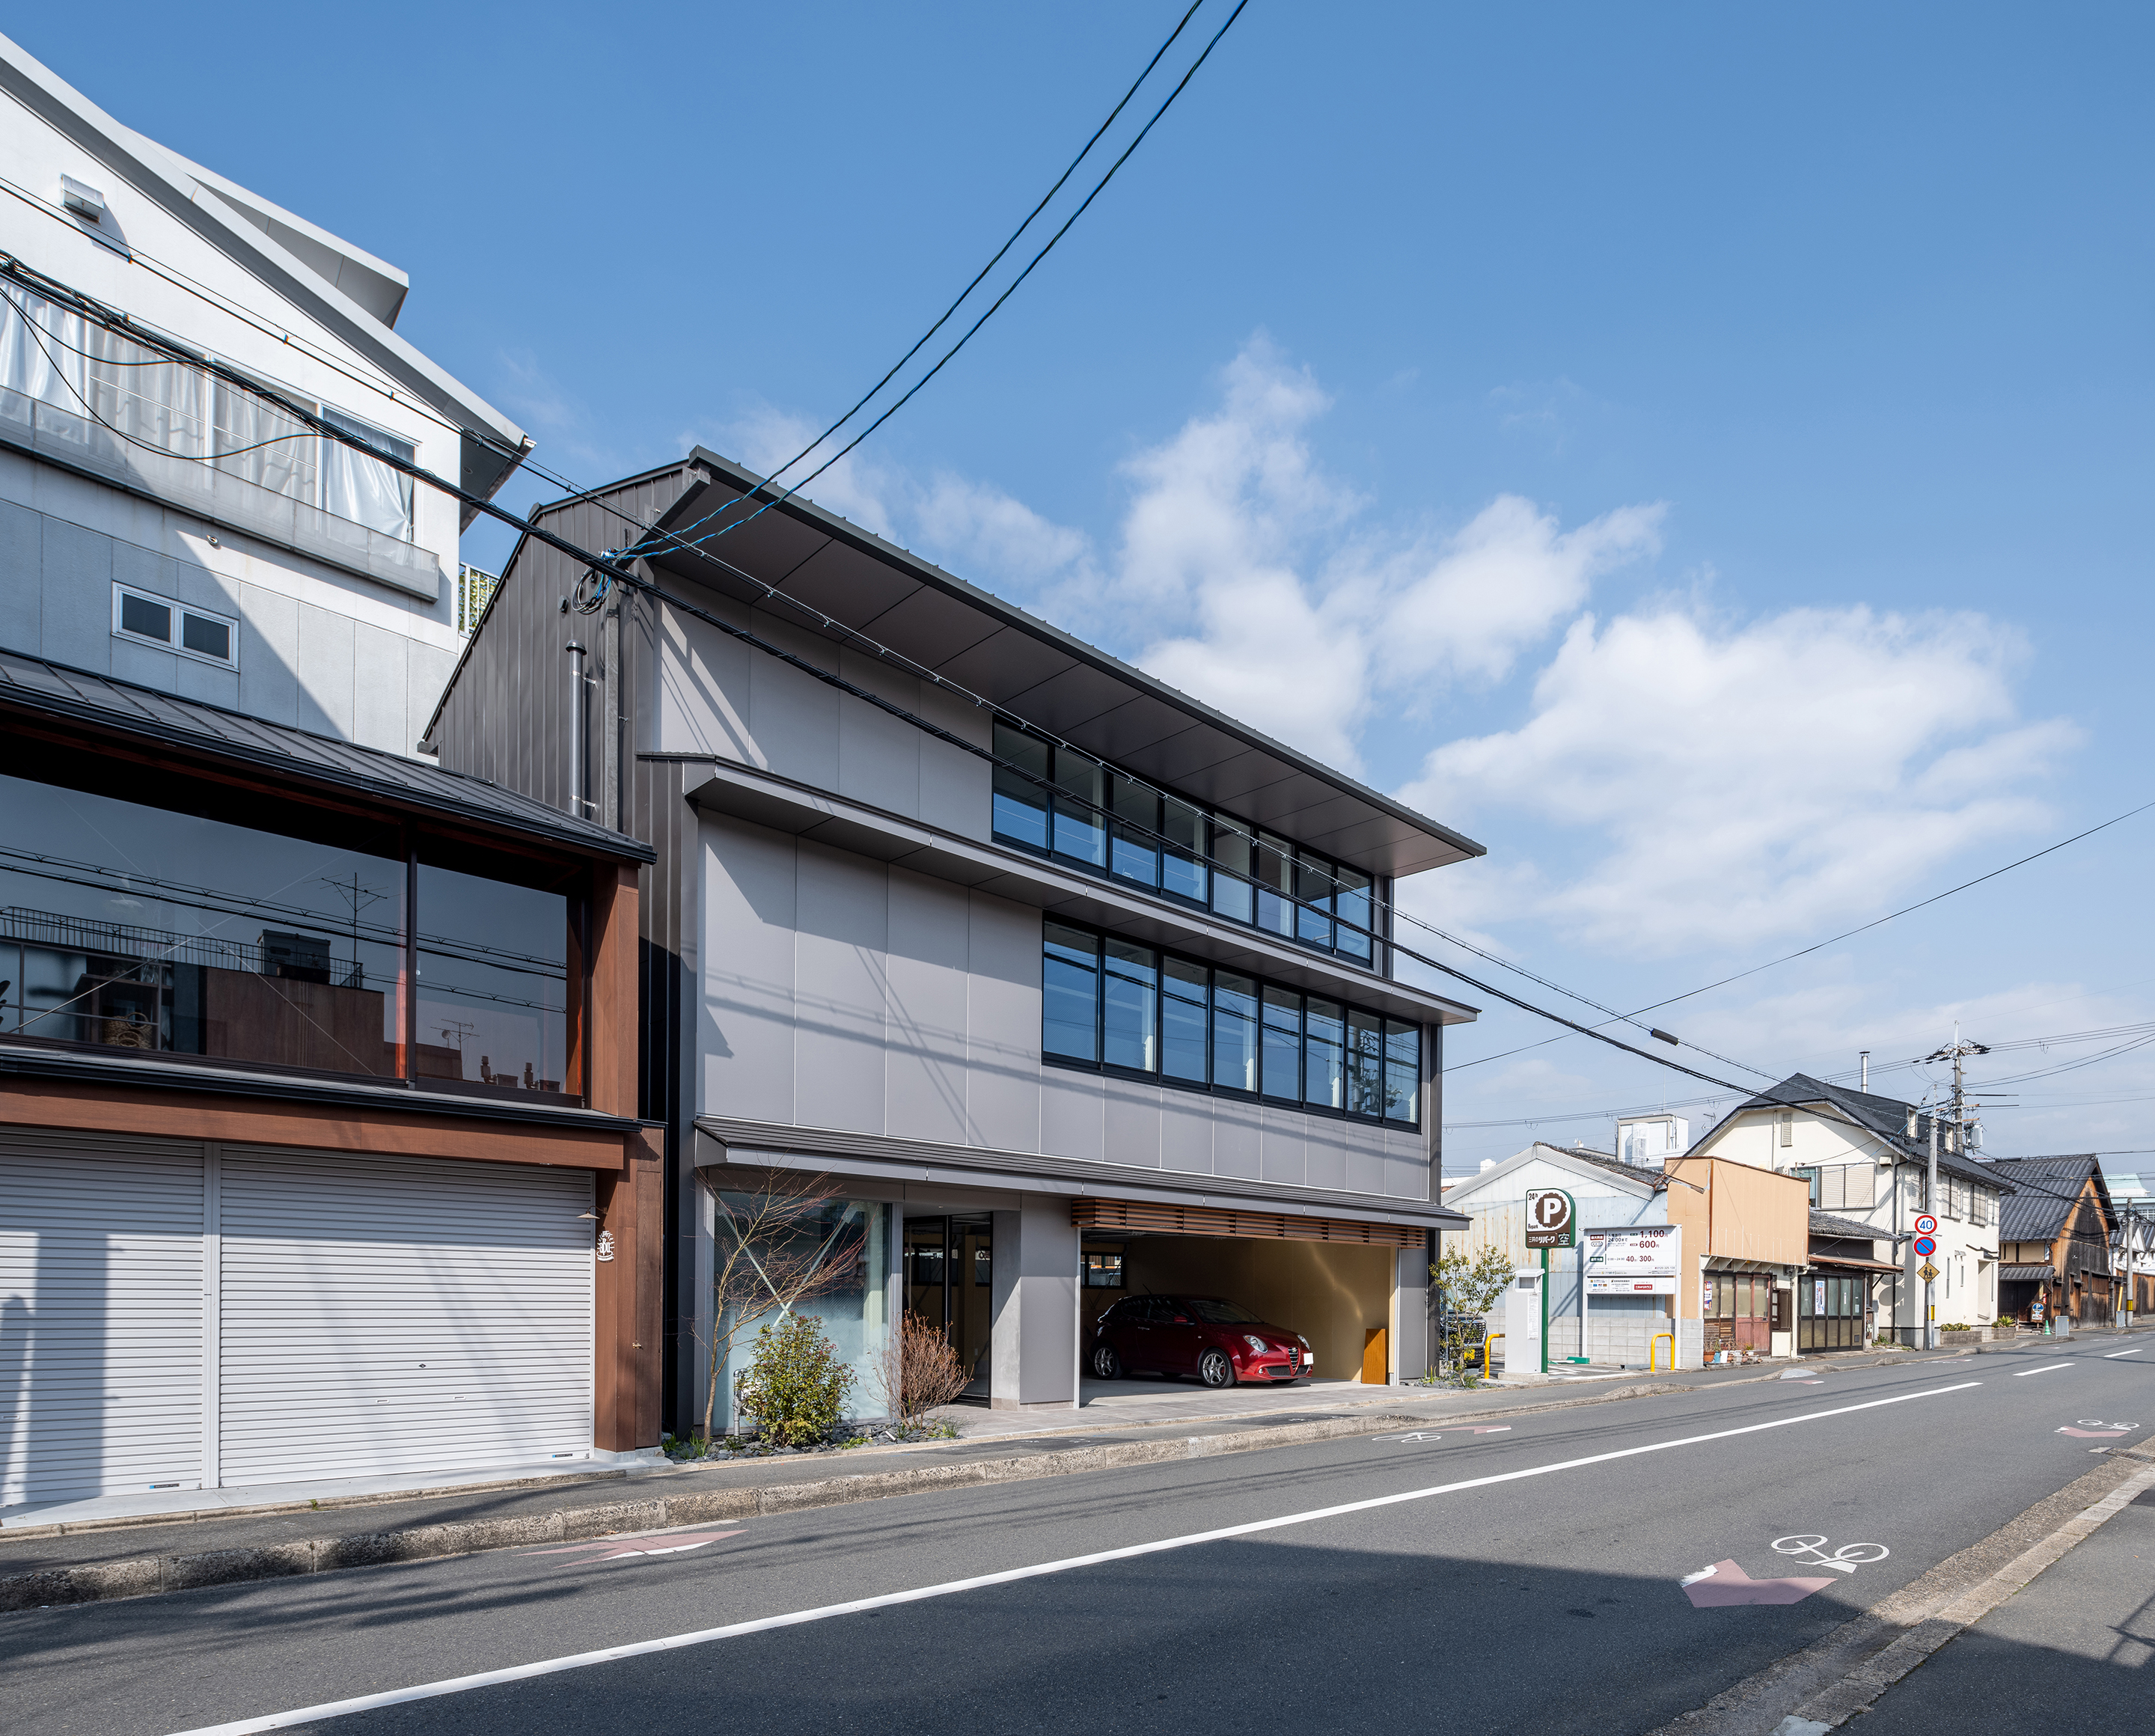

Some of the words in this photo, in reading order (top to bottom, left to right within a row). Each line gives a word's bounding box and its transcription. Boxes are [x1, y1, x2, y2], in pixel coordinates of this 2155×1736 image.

[1543, 1198, 1562, 1224] P
[1919, 1220, 1933, 1229] 40
[1528, 1235, 1556, 1244] 三井のリパーク
[1558, 1232, 1570, 1246] 空
